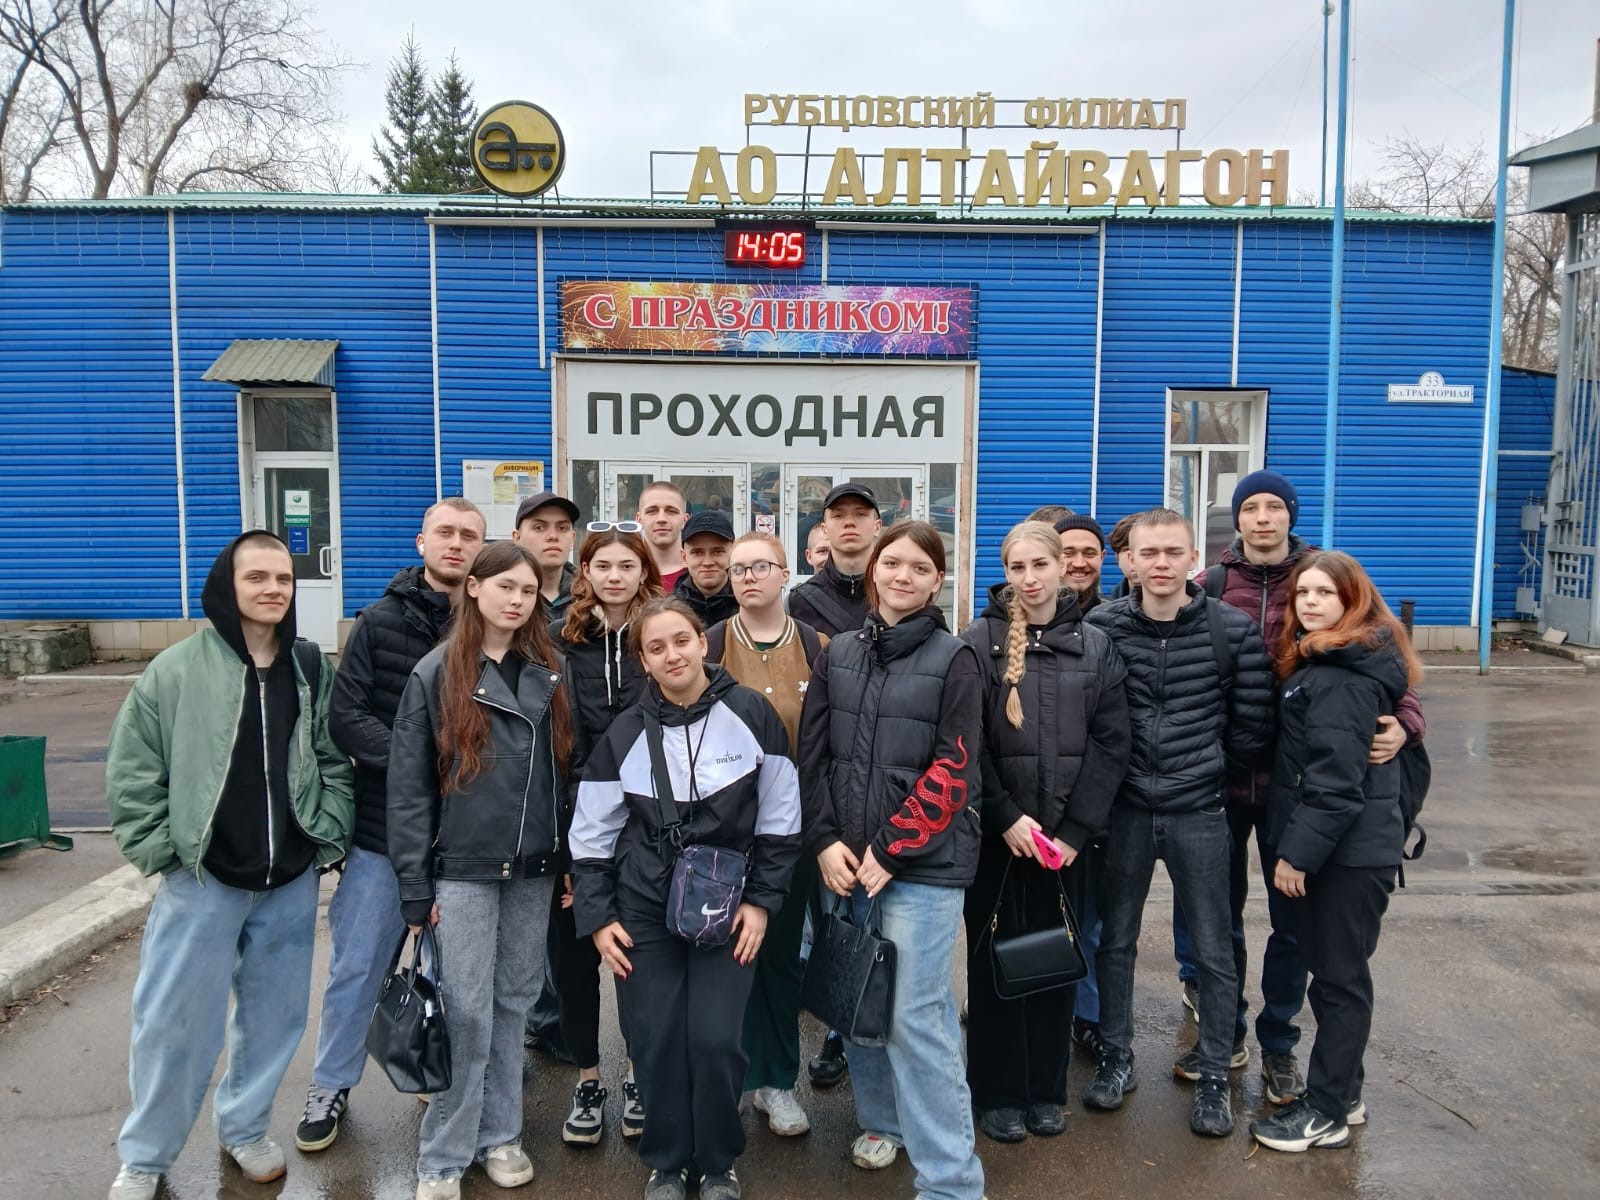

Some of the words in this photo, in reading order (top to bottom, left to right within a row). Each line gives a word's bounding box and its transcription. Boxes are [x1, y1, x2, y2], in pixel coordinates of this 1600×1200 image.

[744, 91, 995, 132] РУБЦОВСКИЙ
[1024, 97, 1187, 130] ФИЛИАЛ
[686, 145, 778, 205] АО
[822, 140, 1290, 207] АЛТАЙВАГОН
[737, 232, 803, 262] 14:05
[583, 294, 617, 329] С
[629, 295, 952, 340] ПРАЗДНИКОМ!
[1425, 375, 1440, 387] 33
[587, 391, 945, 447] ПРОХОДНАЯ
